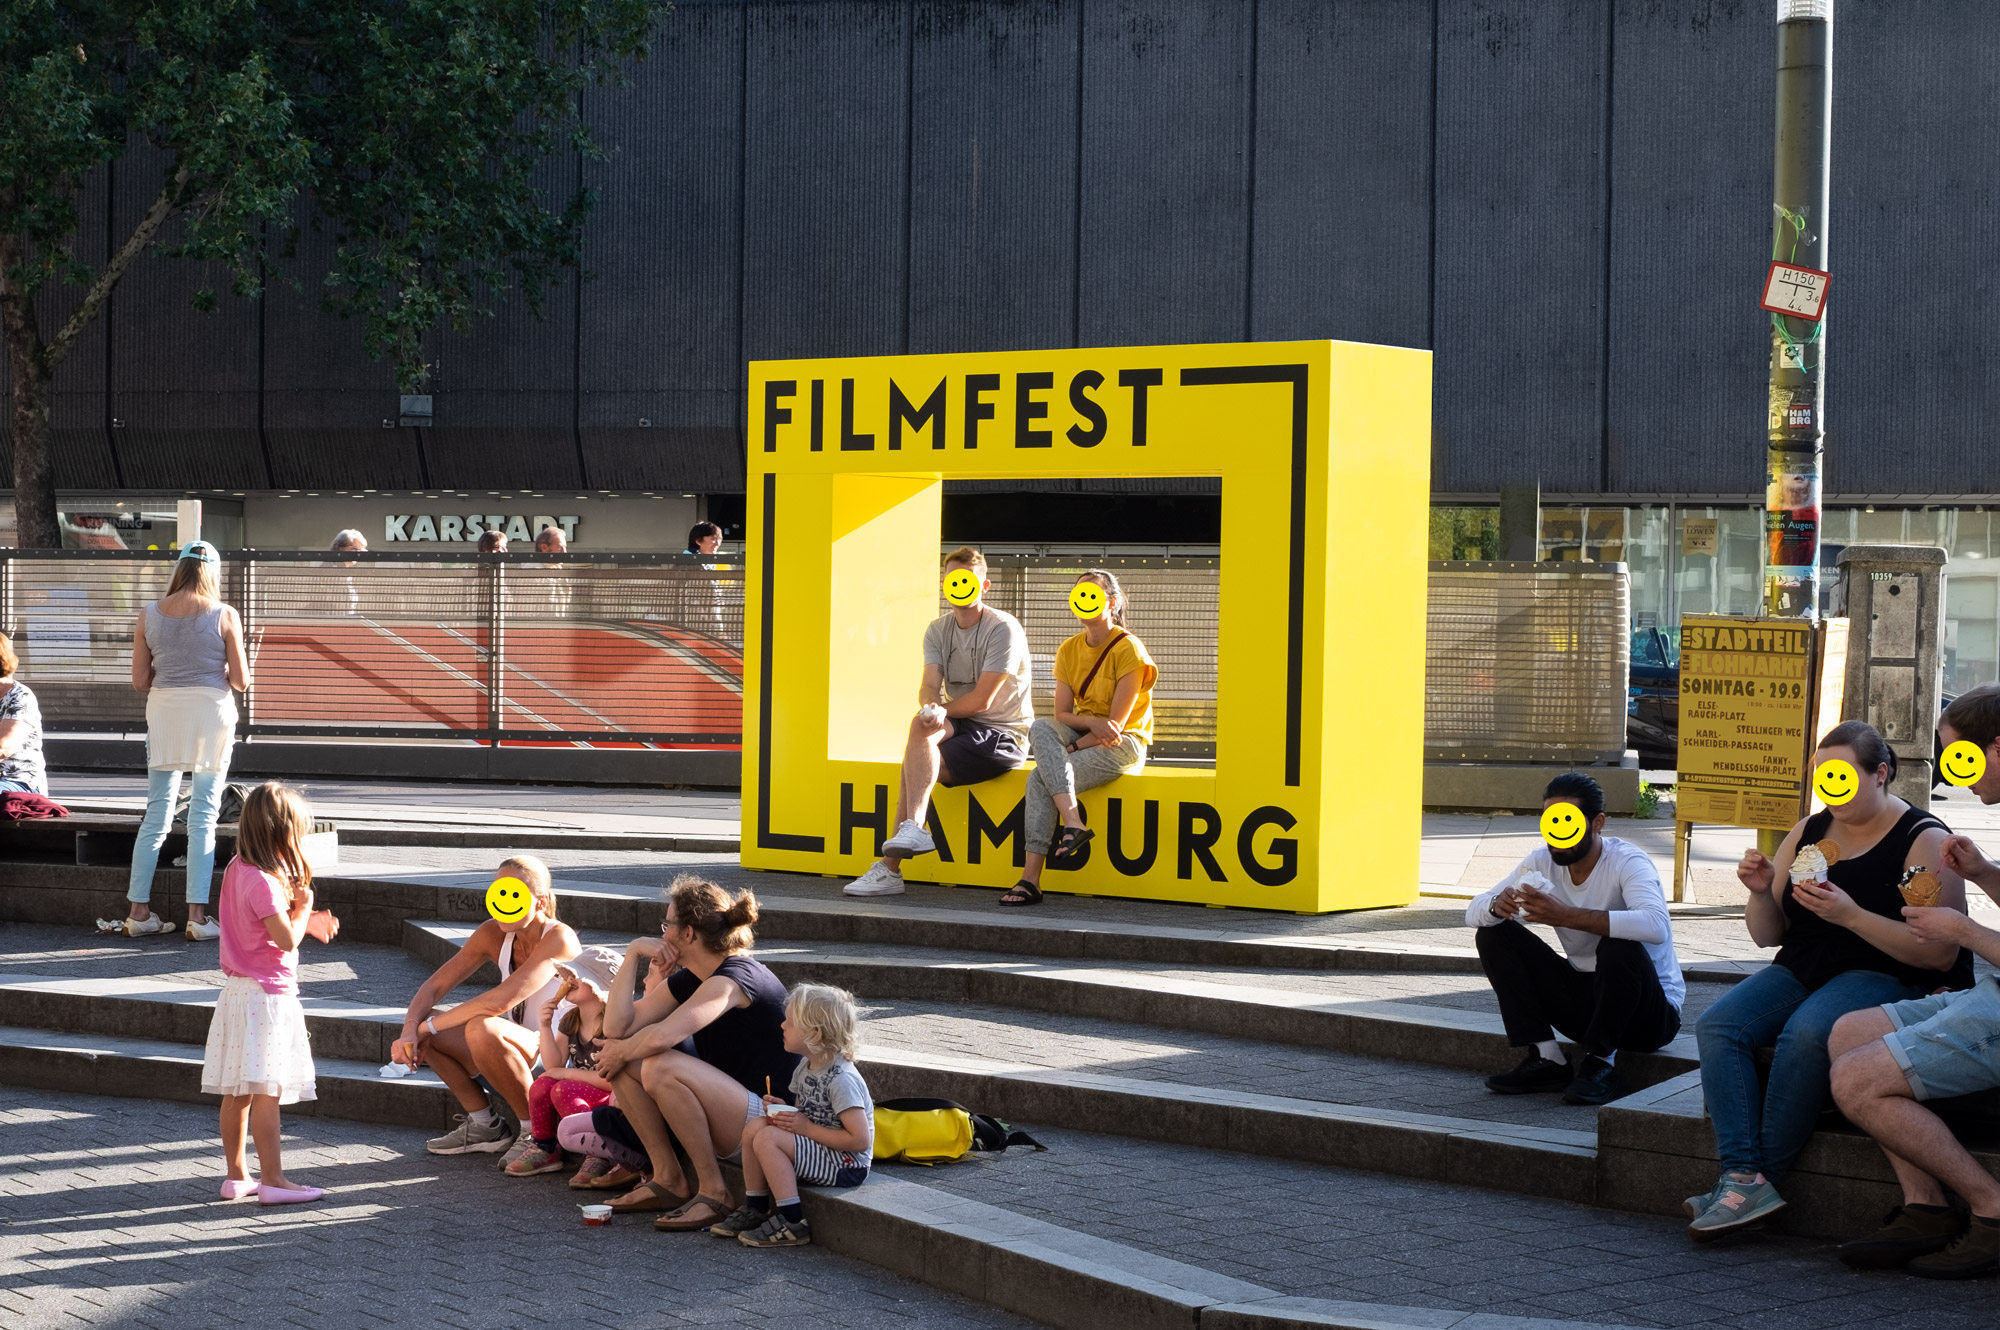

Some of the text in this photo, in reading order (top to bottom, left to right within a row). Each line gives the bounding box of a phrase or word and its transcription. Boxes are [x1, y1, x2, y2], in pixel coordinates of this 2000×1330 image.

[764, 368, 1163, 453] FILMFEST
[385, 514, 579, 542] KARSTADT
[1690, 627, 1805, 653] STADTTEIL
[1690, 654, 1804, 677] FLOHMARKT
[1682, 678, 1755, 696] SONNTAG
[1770, 682, 1804, 699] 29.9.
[1698, 701, 1719, 710] ELSE-
[1688, 710, 1746, 721] RAUCH-PLATZ
[1696, 730, 1721, 738] KARL-
[1736, 725, 1801, 737] STELLINGER WEG
[1684, 738, 1773, 751] SCHNEIDER-PASSAGEN
[1763, 756, 1790, 765] FANNY-
[1713, 761, 1796, 776] MENDELSSOHN-PLATZ
